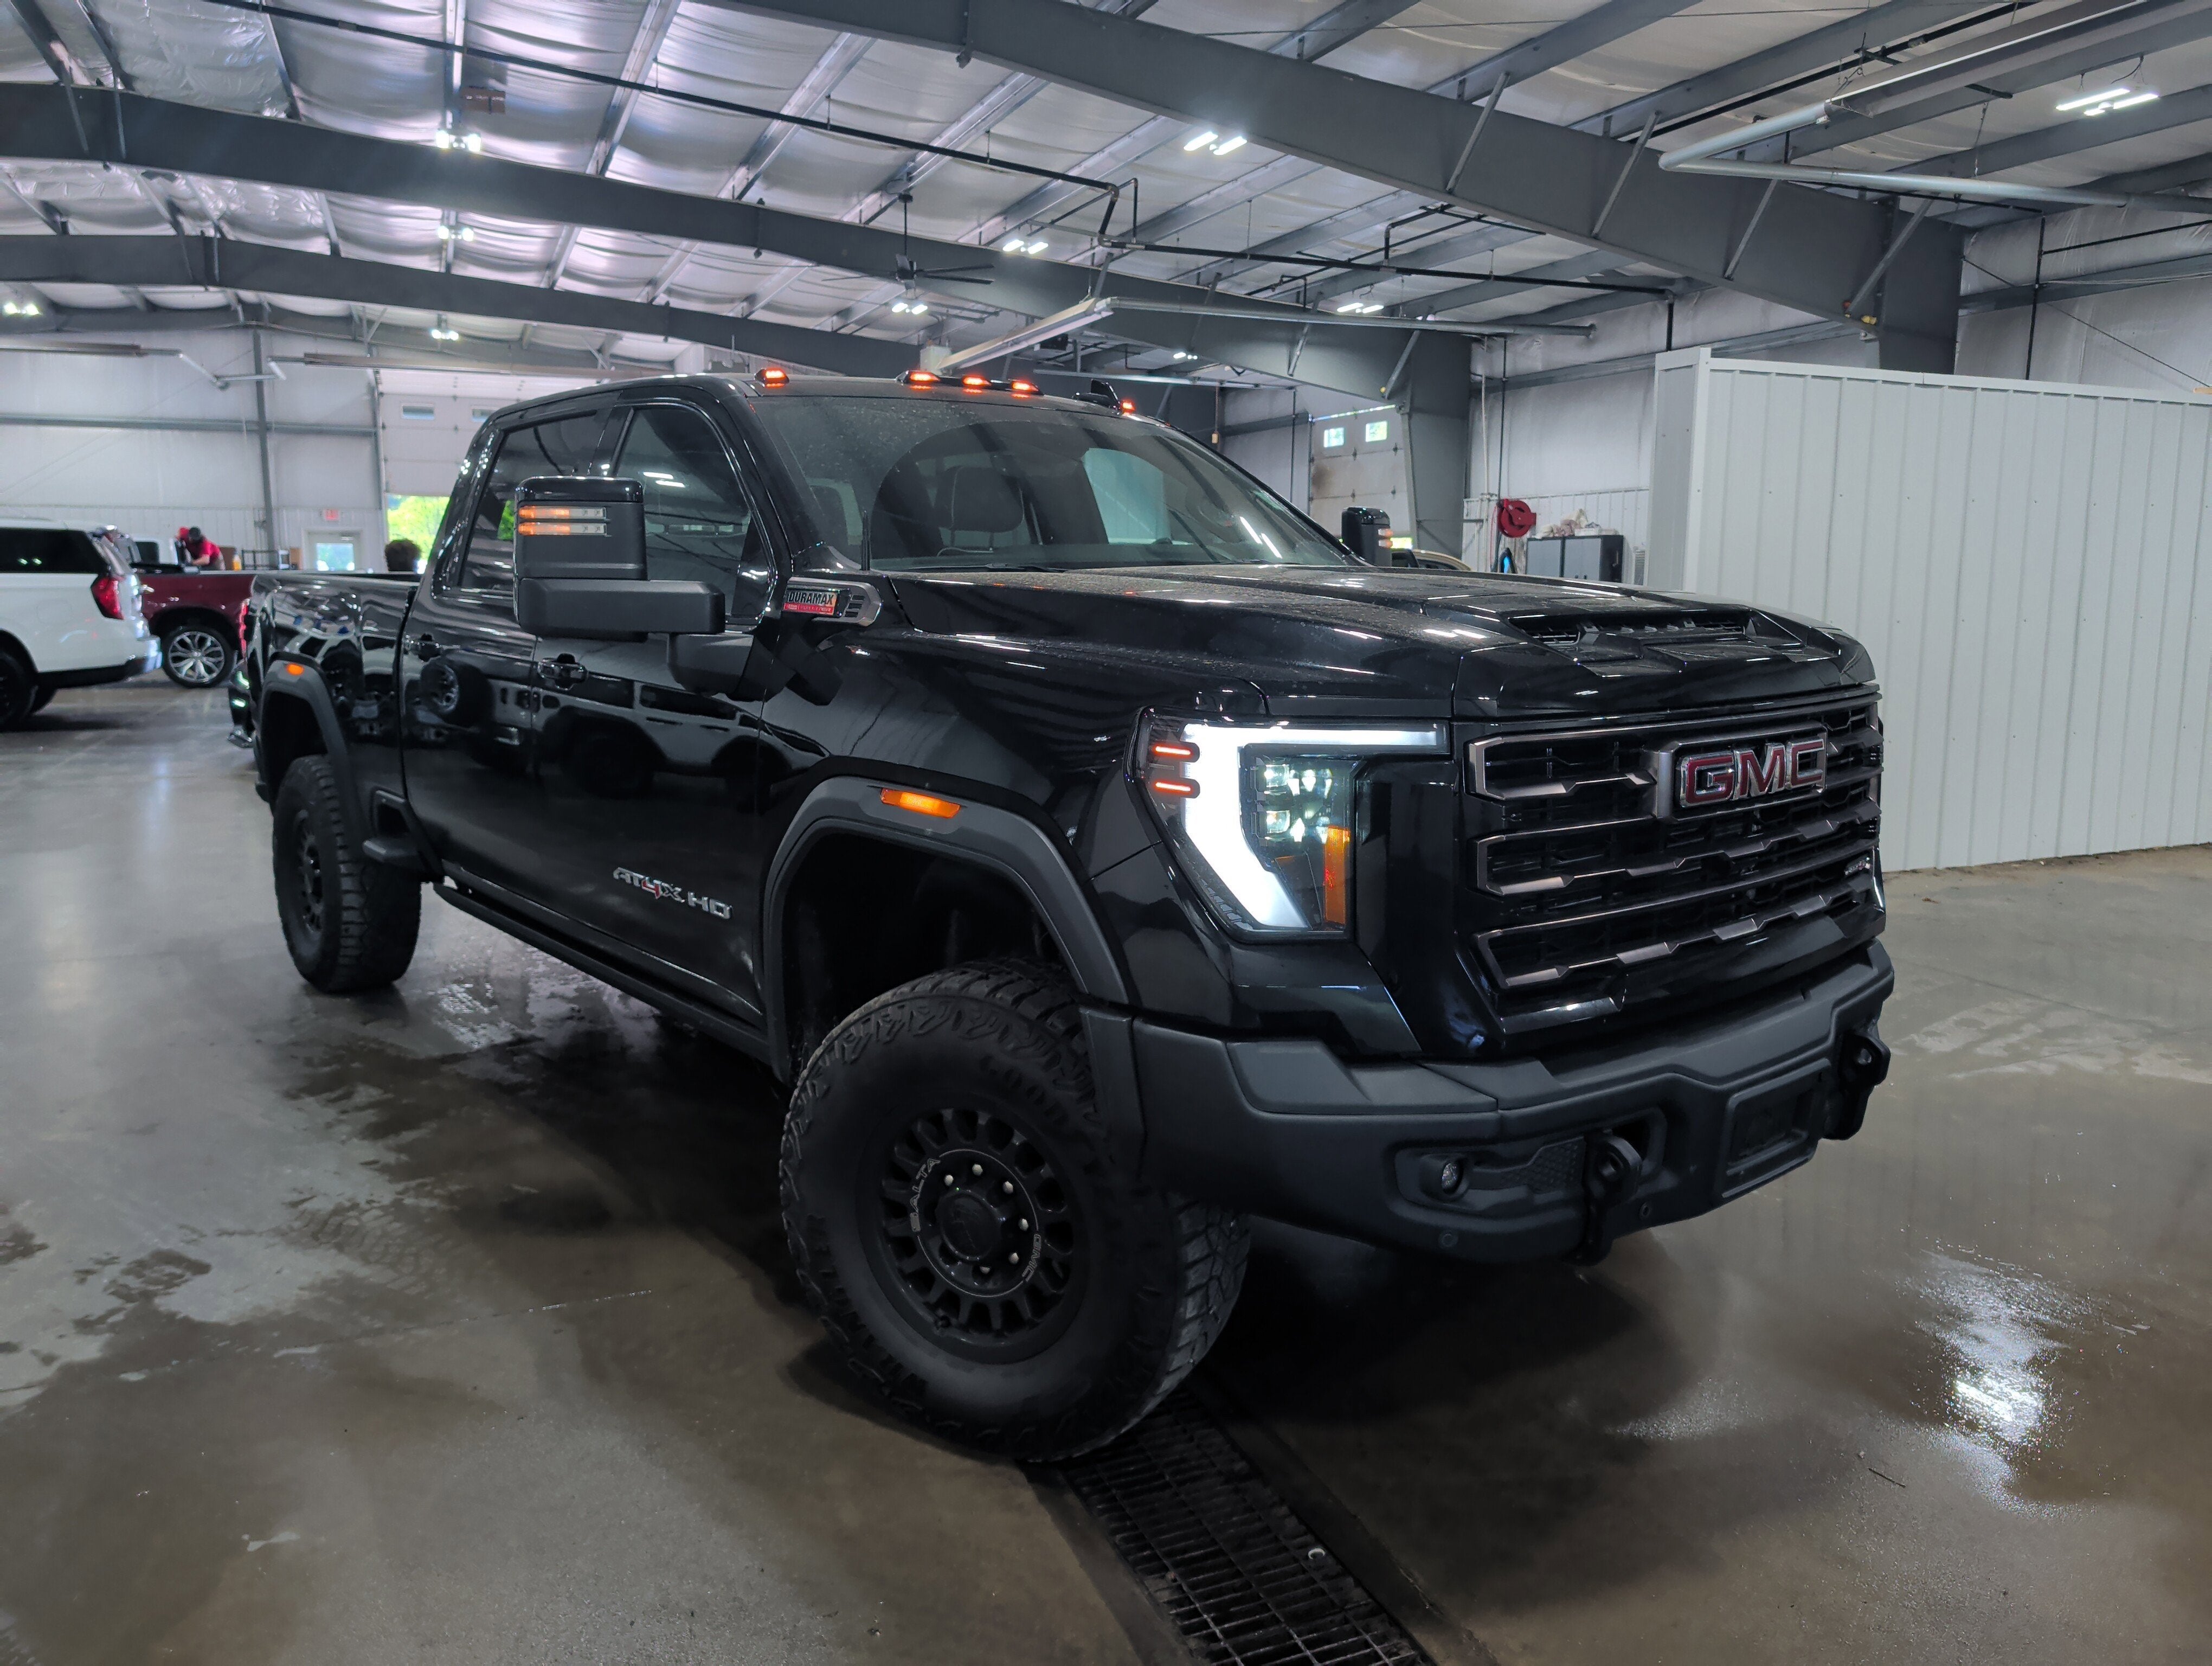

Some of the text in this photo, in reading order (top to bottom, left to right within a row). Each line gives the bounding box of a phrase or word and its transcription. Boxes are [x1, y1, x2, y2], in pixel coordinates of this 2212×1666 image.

[788, 591, 834, 605] DURAMAX
[1680, 739, 1824, 808] GMC
[688, 891, 734, 919] HD
